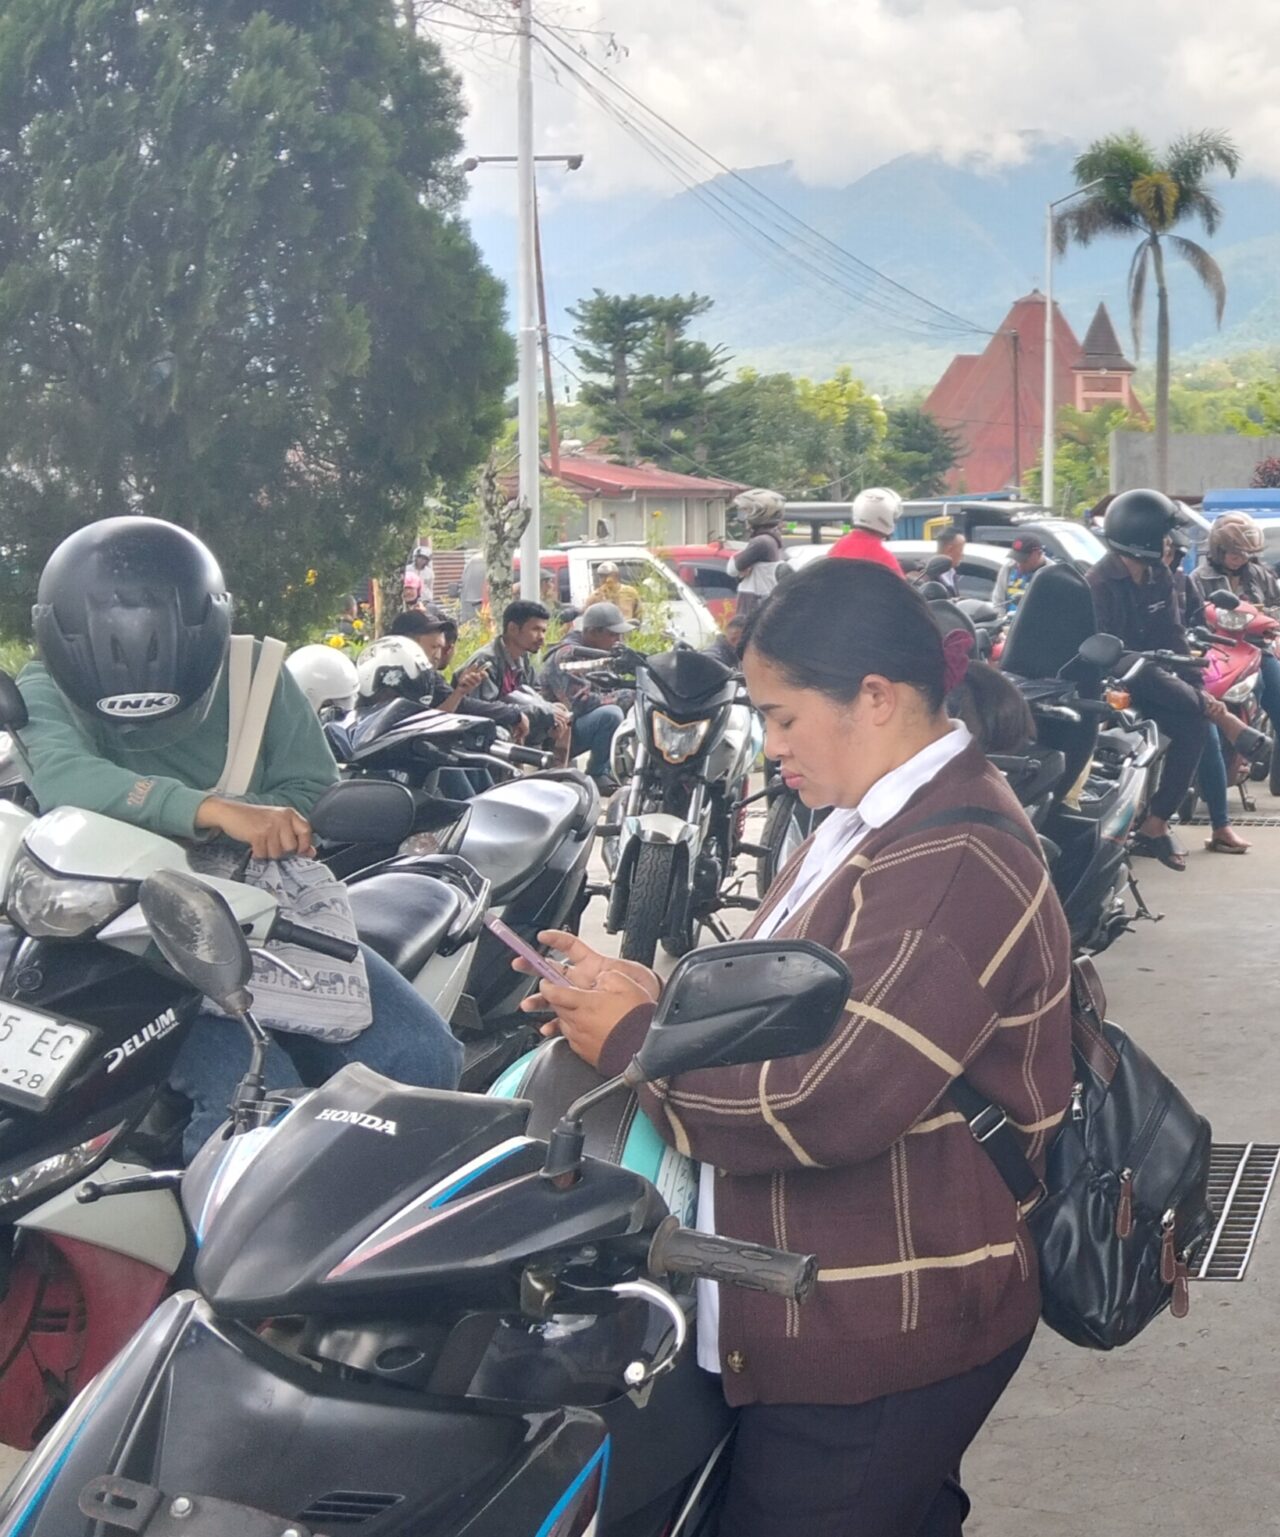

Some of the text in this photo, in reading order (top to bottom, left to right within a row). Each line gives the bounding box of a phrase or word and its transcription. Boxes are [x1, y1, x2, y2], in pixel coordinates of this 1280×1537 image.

[106, 695, 171, 710] INK
[28, 1027, 74, 1061] EC
[103, 1008, 177, 1074] DELIUM
[314, 1108, 397, 1136] HONDA
